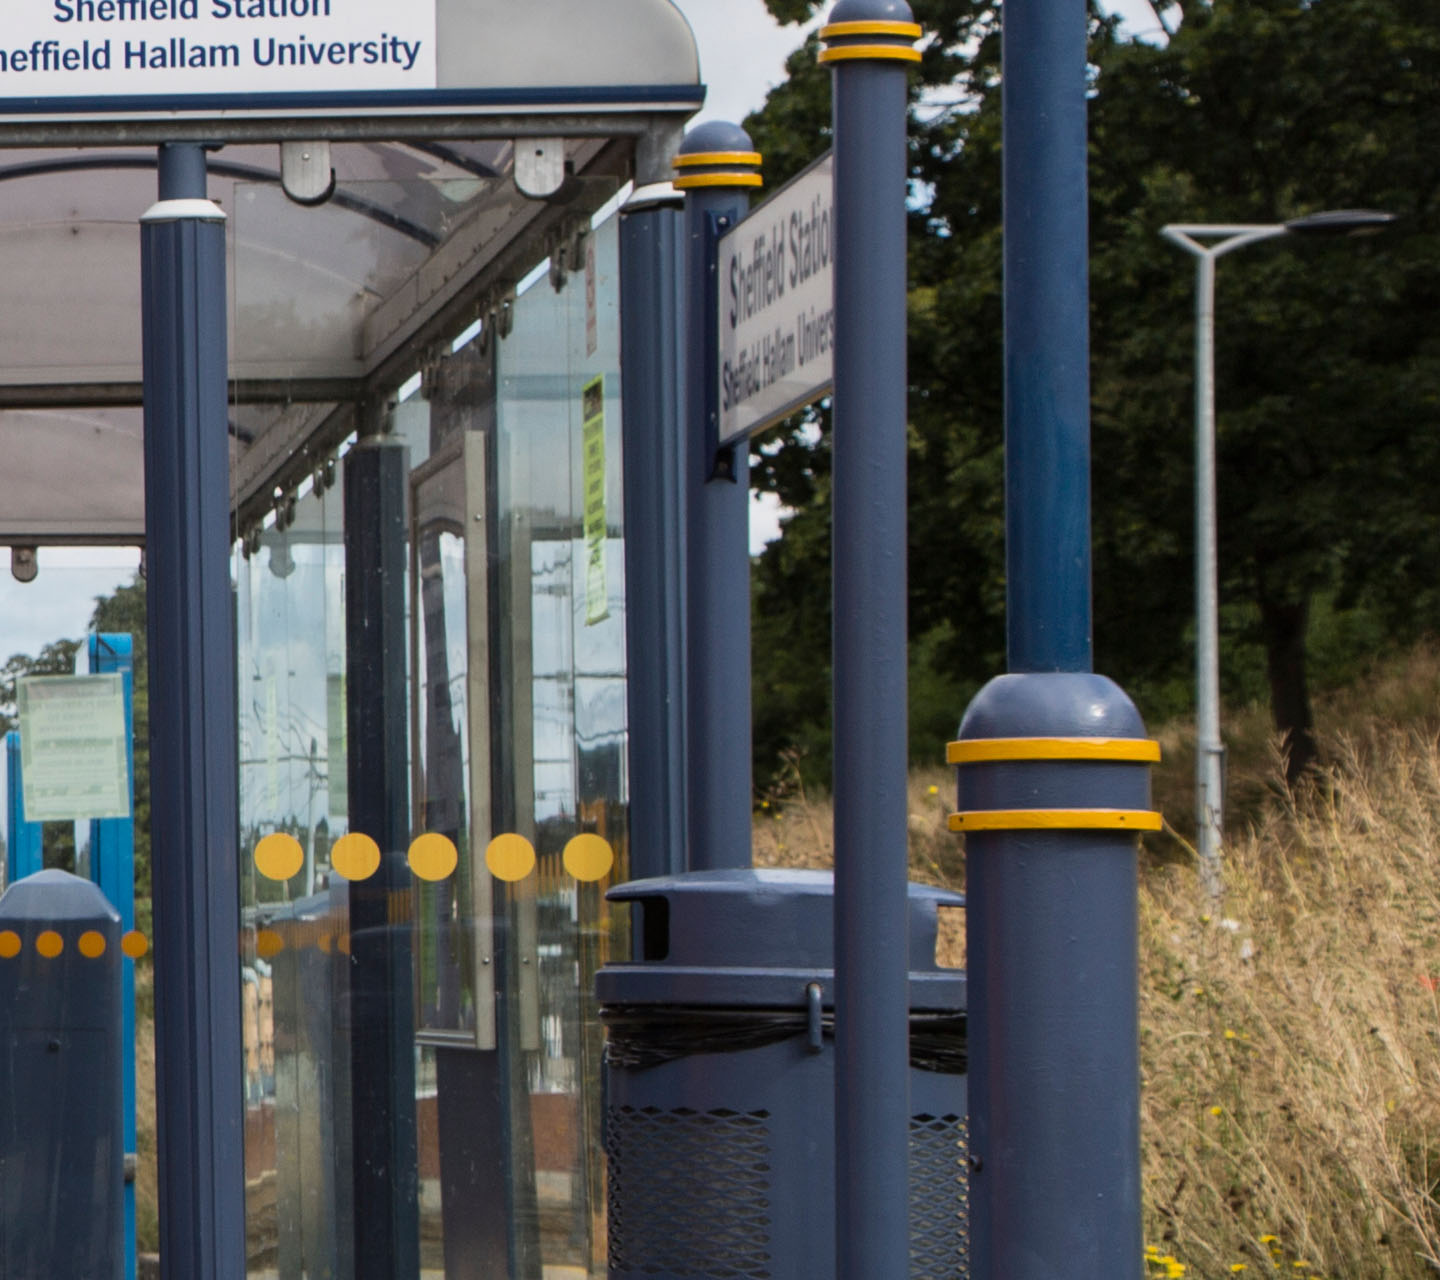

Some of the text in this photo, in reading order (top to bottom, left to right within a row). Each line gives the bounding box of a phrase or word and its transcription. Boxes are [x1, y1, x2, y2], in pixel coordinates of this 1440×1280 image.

[122, 36, 241, 70] Hallam
[252, 31, 422, 71] University
[729, 217, 785, 329] Sheffield
